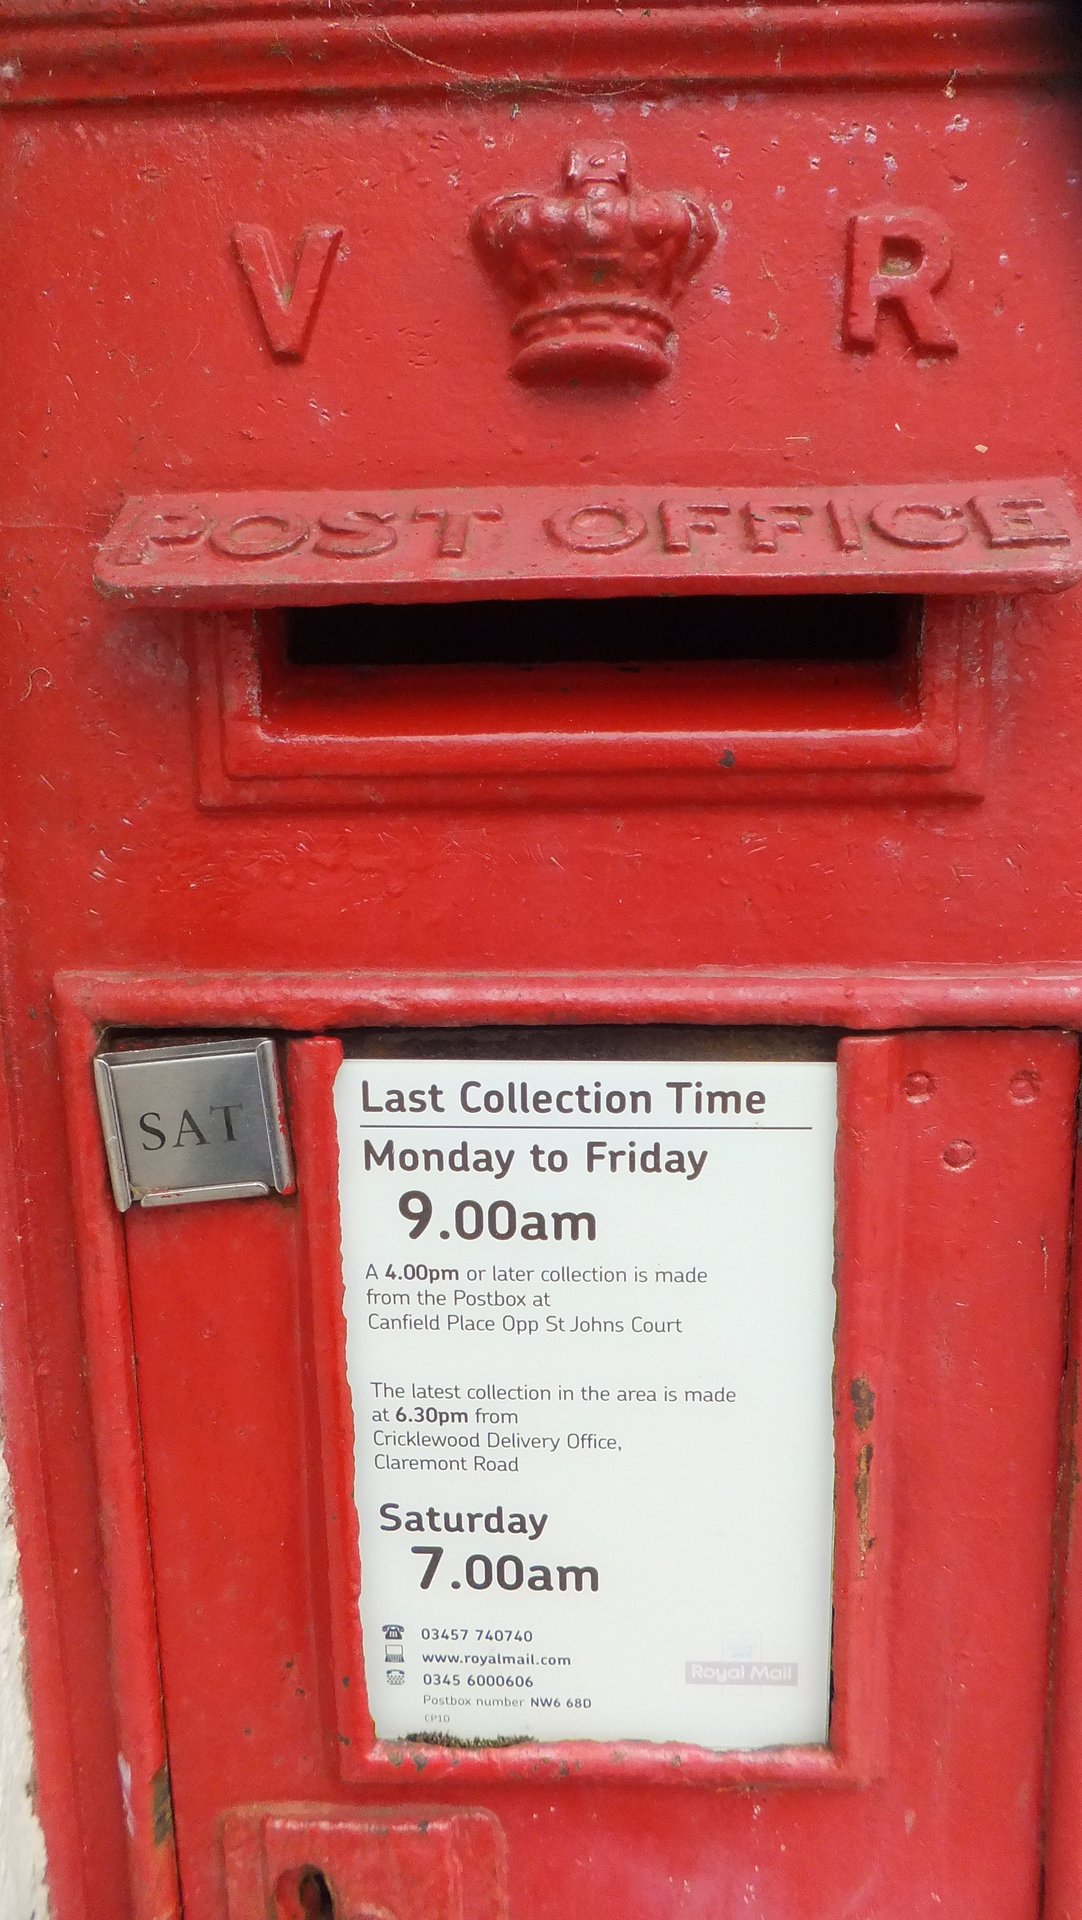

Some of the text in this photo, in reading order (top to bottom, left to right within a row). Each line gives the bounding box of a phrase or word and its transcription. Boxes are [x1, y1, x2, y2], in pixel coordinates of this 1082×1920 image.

[232, 209, 957, 361] V R
[118, 494, 1072, 565] POST OFFICE
[362, 1080, 765, 1114] Last Collection Time
[139, 1103, 243, 1151] SAT
[364, 1139, 708, 1180] Monday to Friday
[399, 1190, 596, 1241] 9.00am
[365, 1263, 707, 1285] A 4.00pm or later collection is made
[366, 1288, 550, 1307] from the Postbox at
[368, 1312, 682, 1336] Canfield Place Opp St Johns Court
[369, 1381, 736, 1403] The latest collection in the area is made
[371, 1406, 518, 1427] at 6.30pm from
[373, 1429, 621, 1453] Cricklewood Delivery Office,
[374, 1453, 518, 1472] Claremont Road
[380, 1503, 548, 1540] Saturday
[411, 1546, 598, 1591] 7.00am
[421, 1627, 532, 1643] 03457 740740
[421, 1652, 570, 1667] www.royalmail.com
[423, 1673, 533, 1688] 0345 6000606
[691, 1663, 792, 1682] Royal Mail
[423, 1694, 591, 1709] Postbox number NW6 68D
